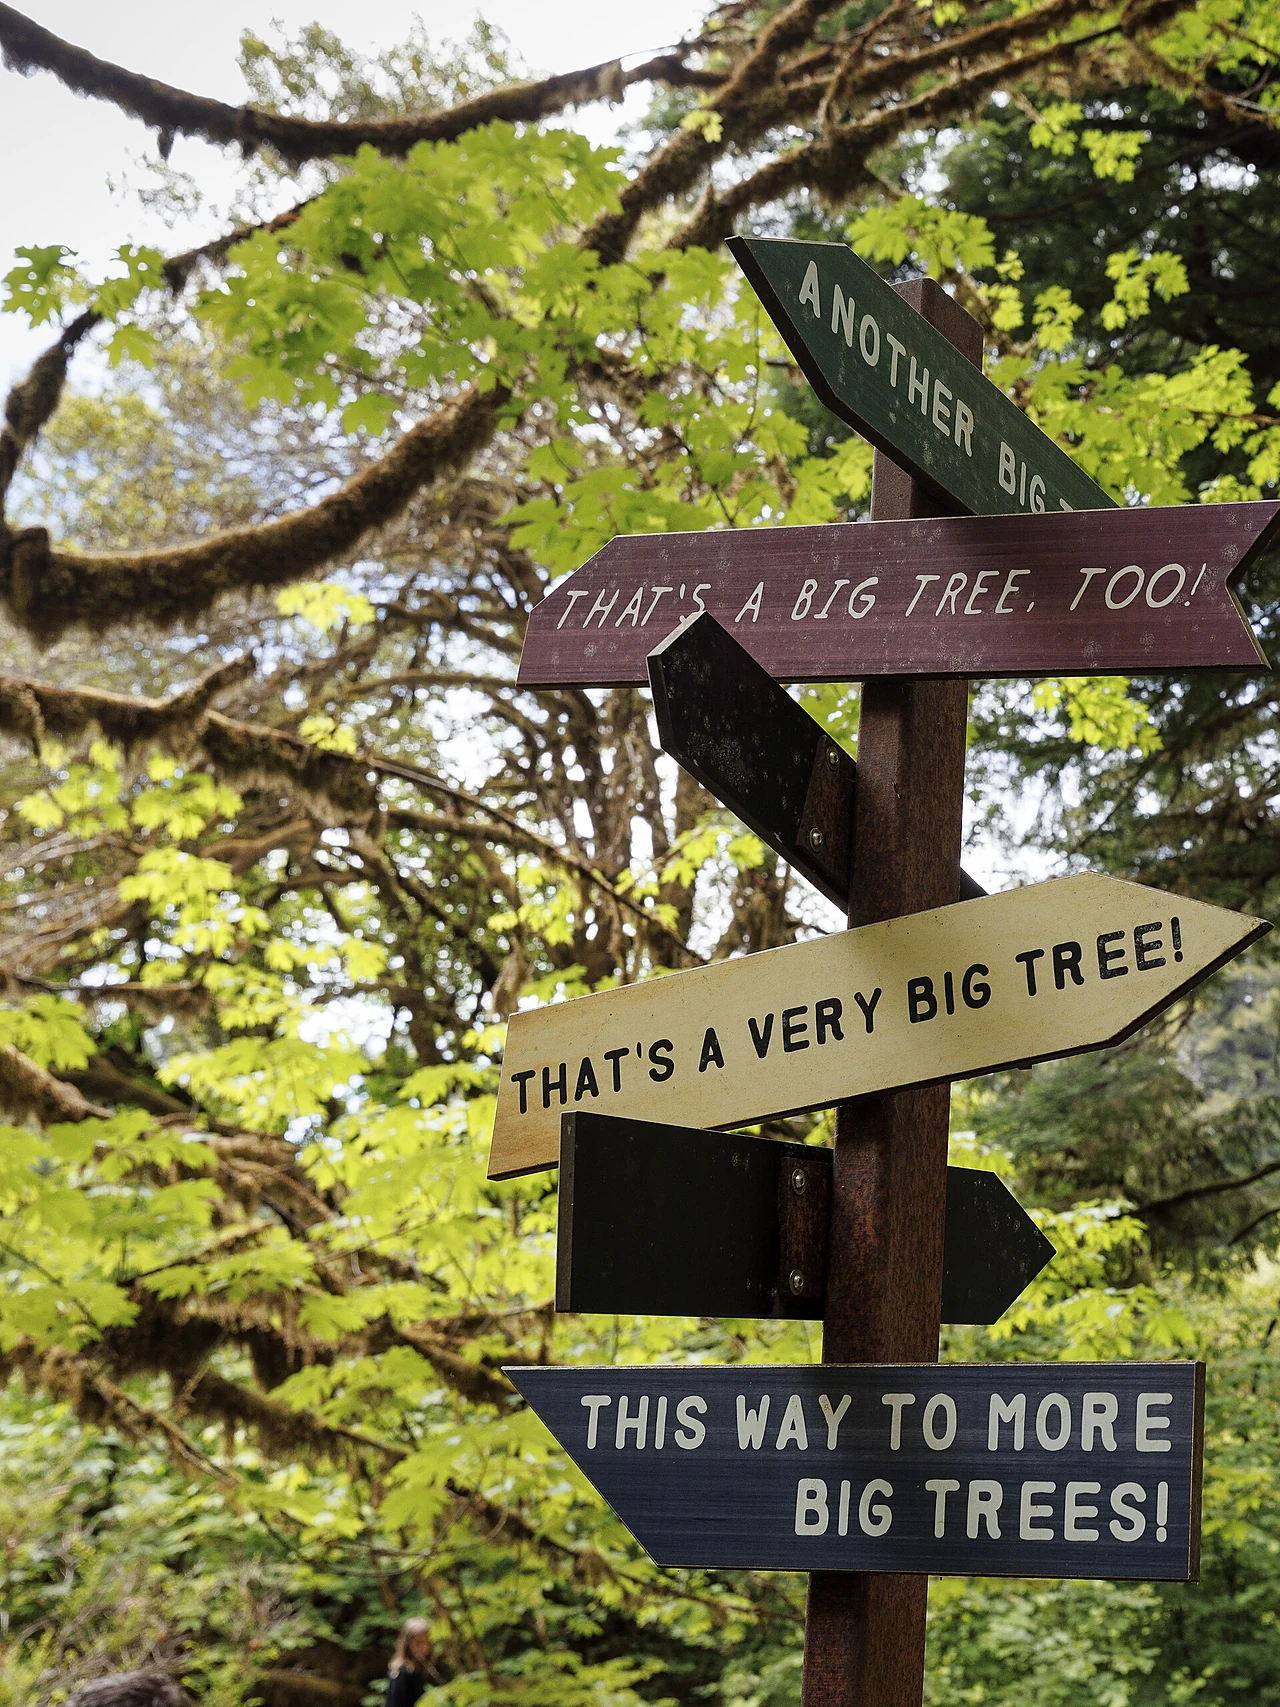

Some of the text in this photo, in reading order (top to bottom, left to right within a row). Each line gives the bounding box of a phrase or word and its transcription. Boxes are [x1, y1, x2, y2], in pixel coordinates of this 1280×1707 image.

[799, 259, 1046, 513] ANOTHER BIG
[556, 563, 1207, 630] THAT'S A BIG TREE, TOO!
[511, 916, 1183, 1114] THAT'S A VERY BIG TREE!
[581, 1392, 1173, 1453] THIS WAY TO MORE
[794, 1478, 1169, 1542] BIG TREES!
